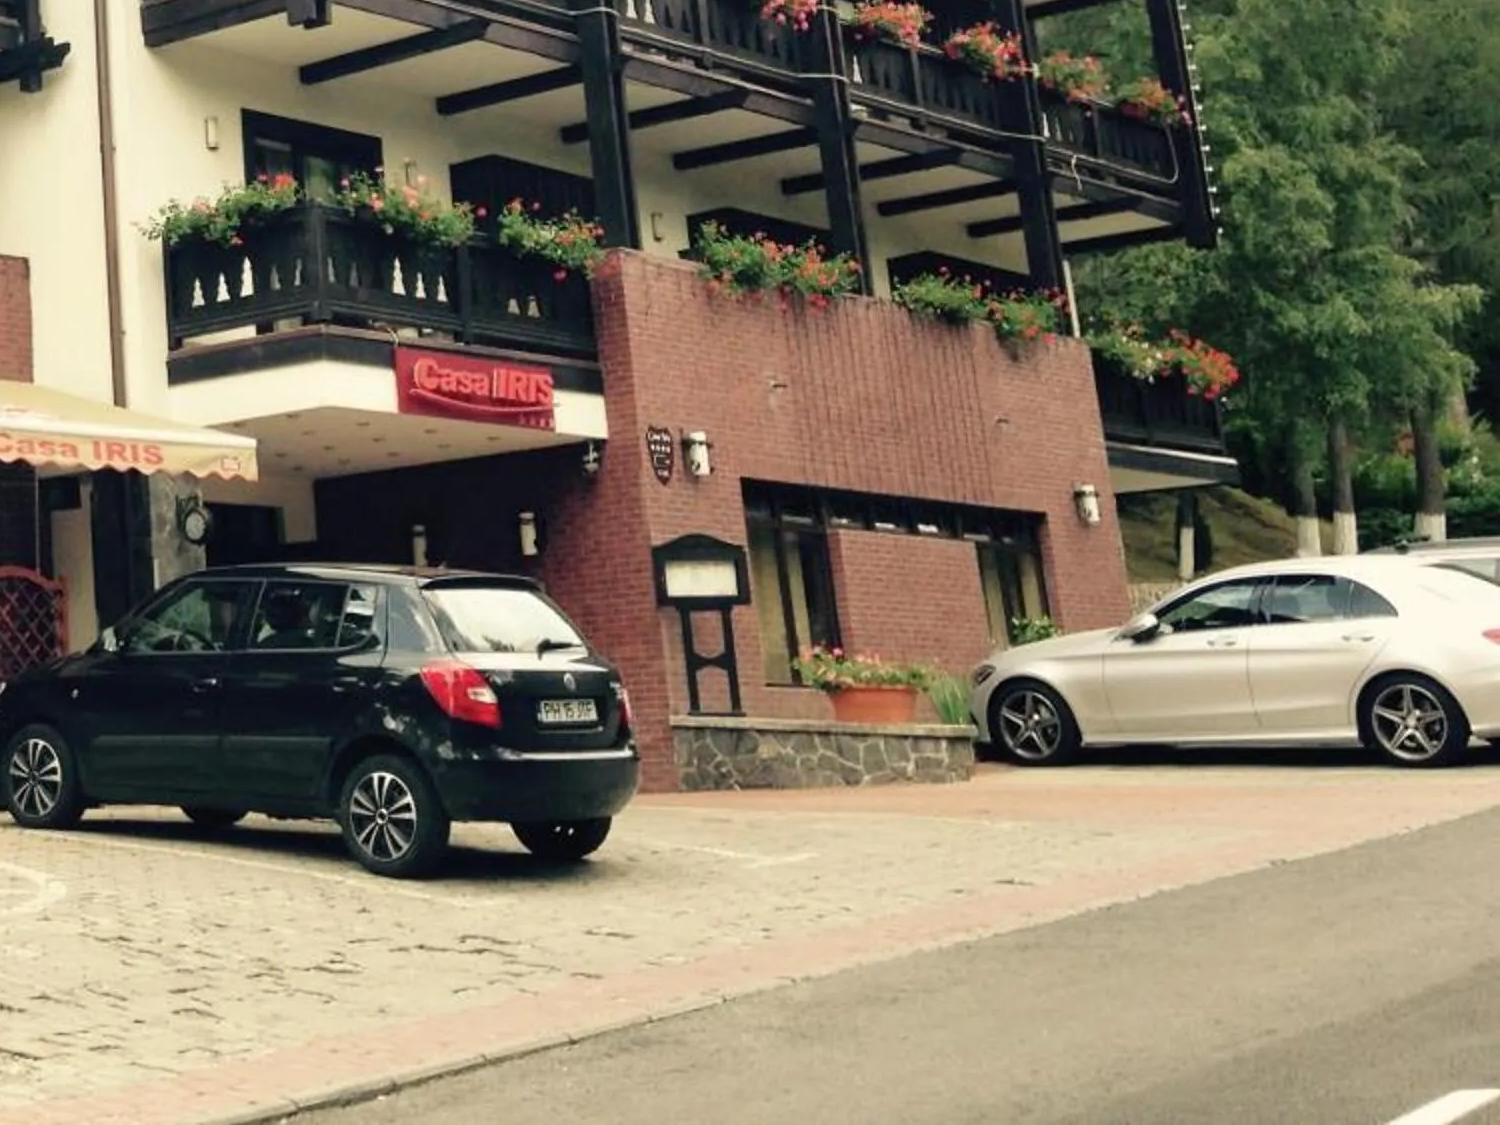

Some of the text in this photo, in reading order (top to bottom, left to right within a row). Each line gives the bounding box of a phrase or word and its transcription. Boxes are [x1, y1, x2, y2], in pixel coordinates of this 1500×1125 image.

[413, 358, 554, 405] Casa IRIS
[92, 440, 164, 466] IRIS
